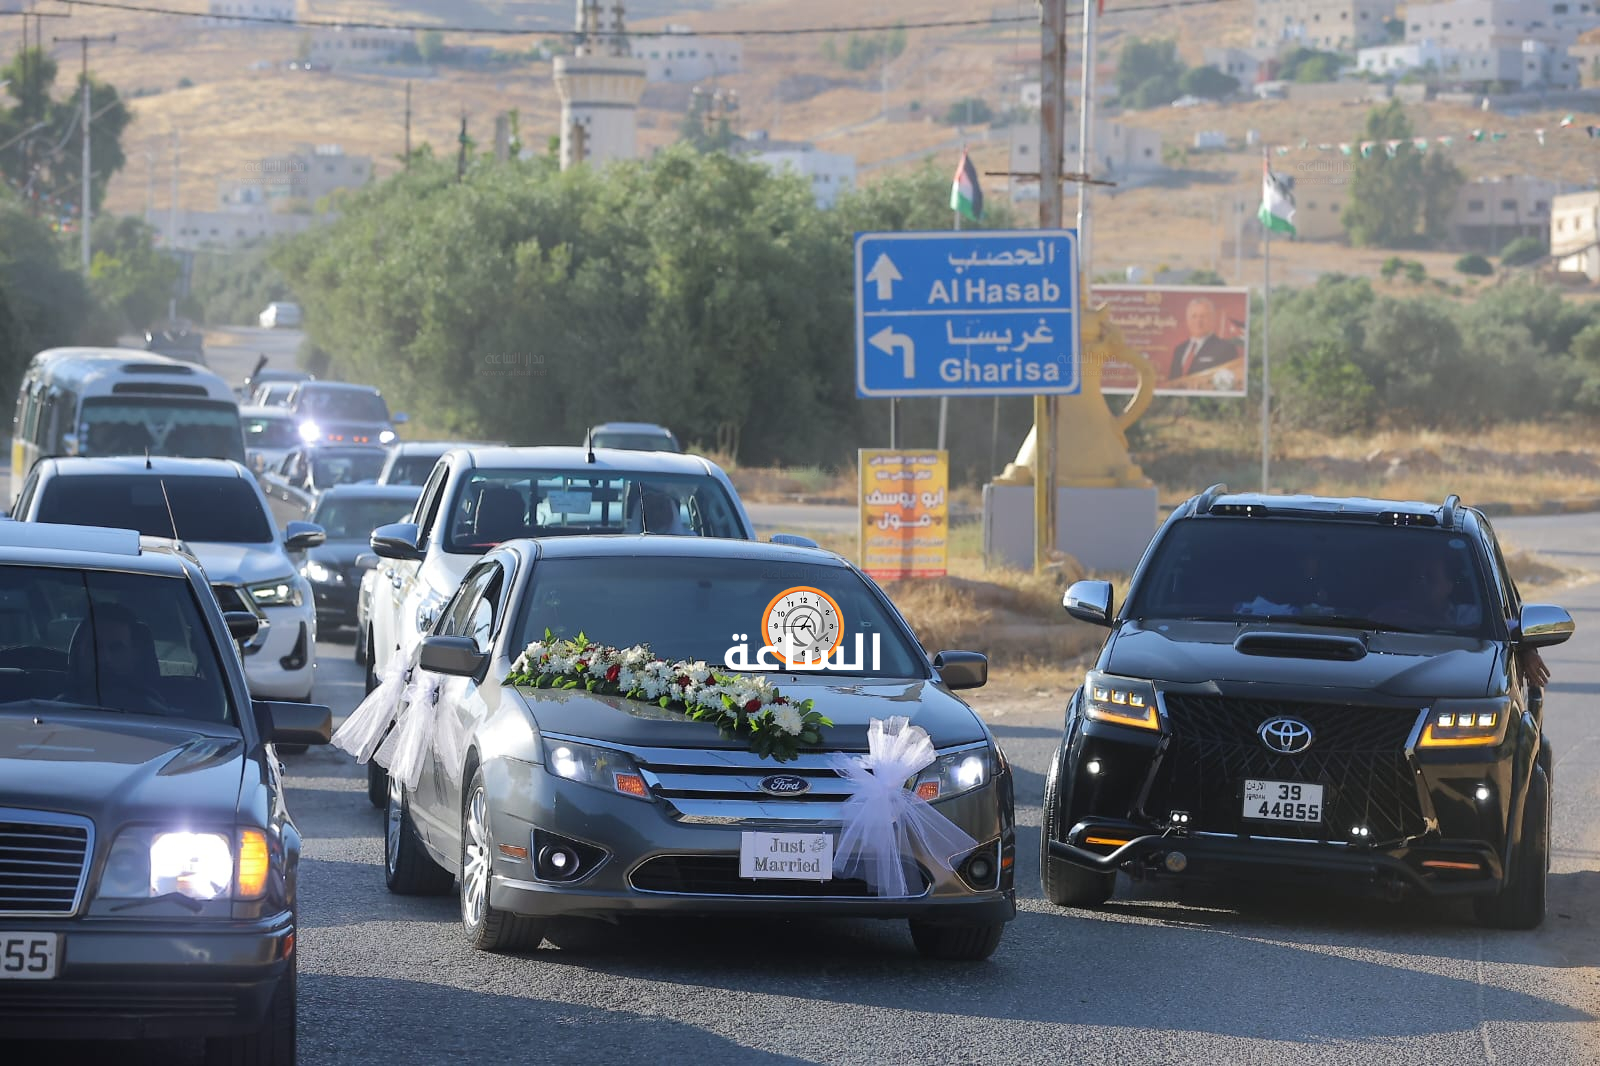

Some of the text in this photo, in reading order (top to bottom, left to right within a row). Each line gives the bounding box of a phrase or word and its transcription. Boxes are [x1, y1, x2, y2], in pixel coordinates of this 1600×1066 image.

[927, 278, 1061, 304] Al Hasab
[945, 318, 1054, 352] غريسا
[939, 357, 1061, 382] Gharisa
[865, 489, 917, 508] يوسف
[878, 511, 931, 531] مول
[770, 777, 800, 790] Ford
[1278, 784, 1302, 801] 39
[1258, 800, 1319, 820] 44855
[770, 838, 806, 853] Just
[753, 857, 820, 873] Married
[0, 939, 48, 972] 55
